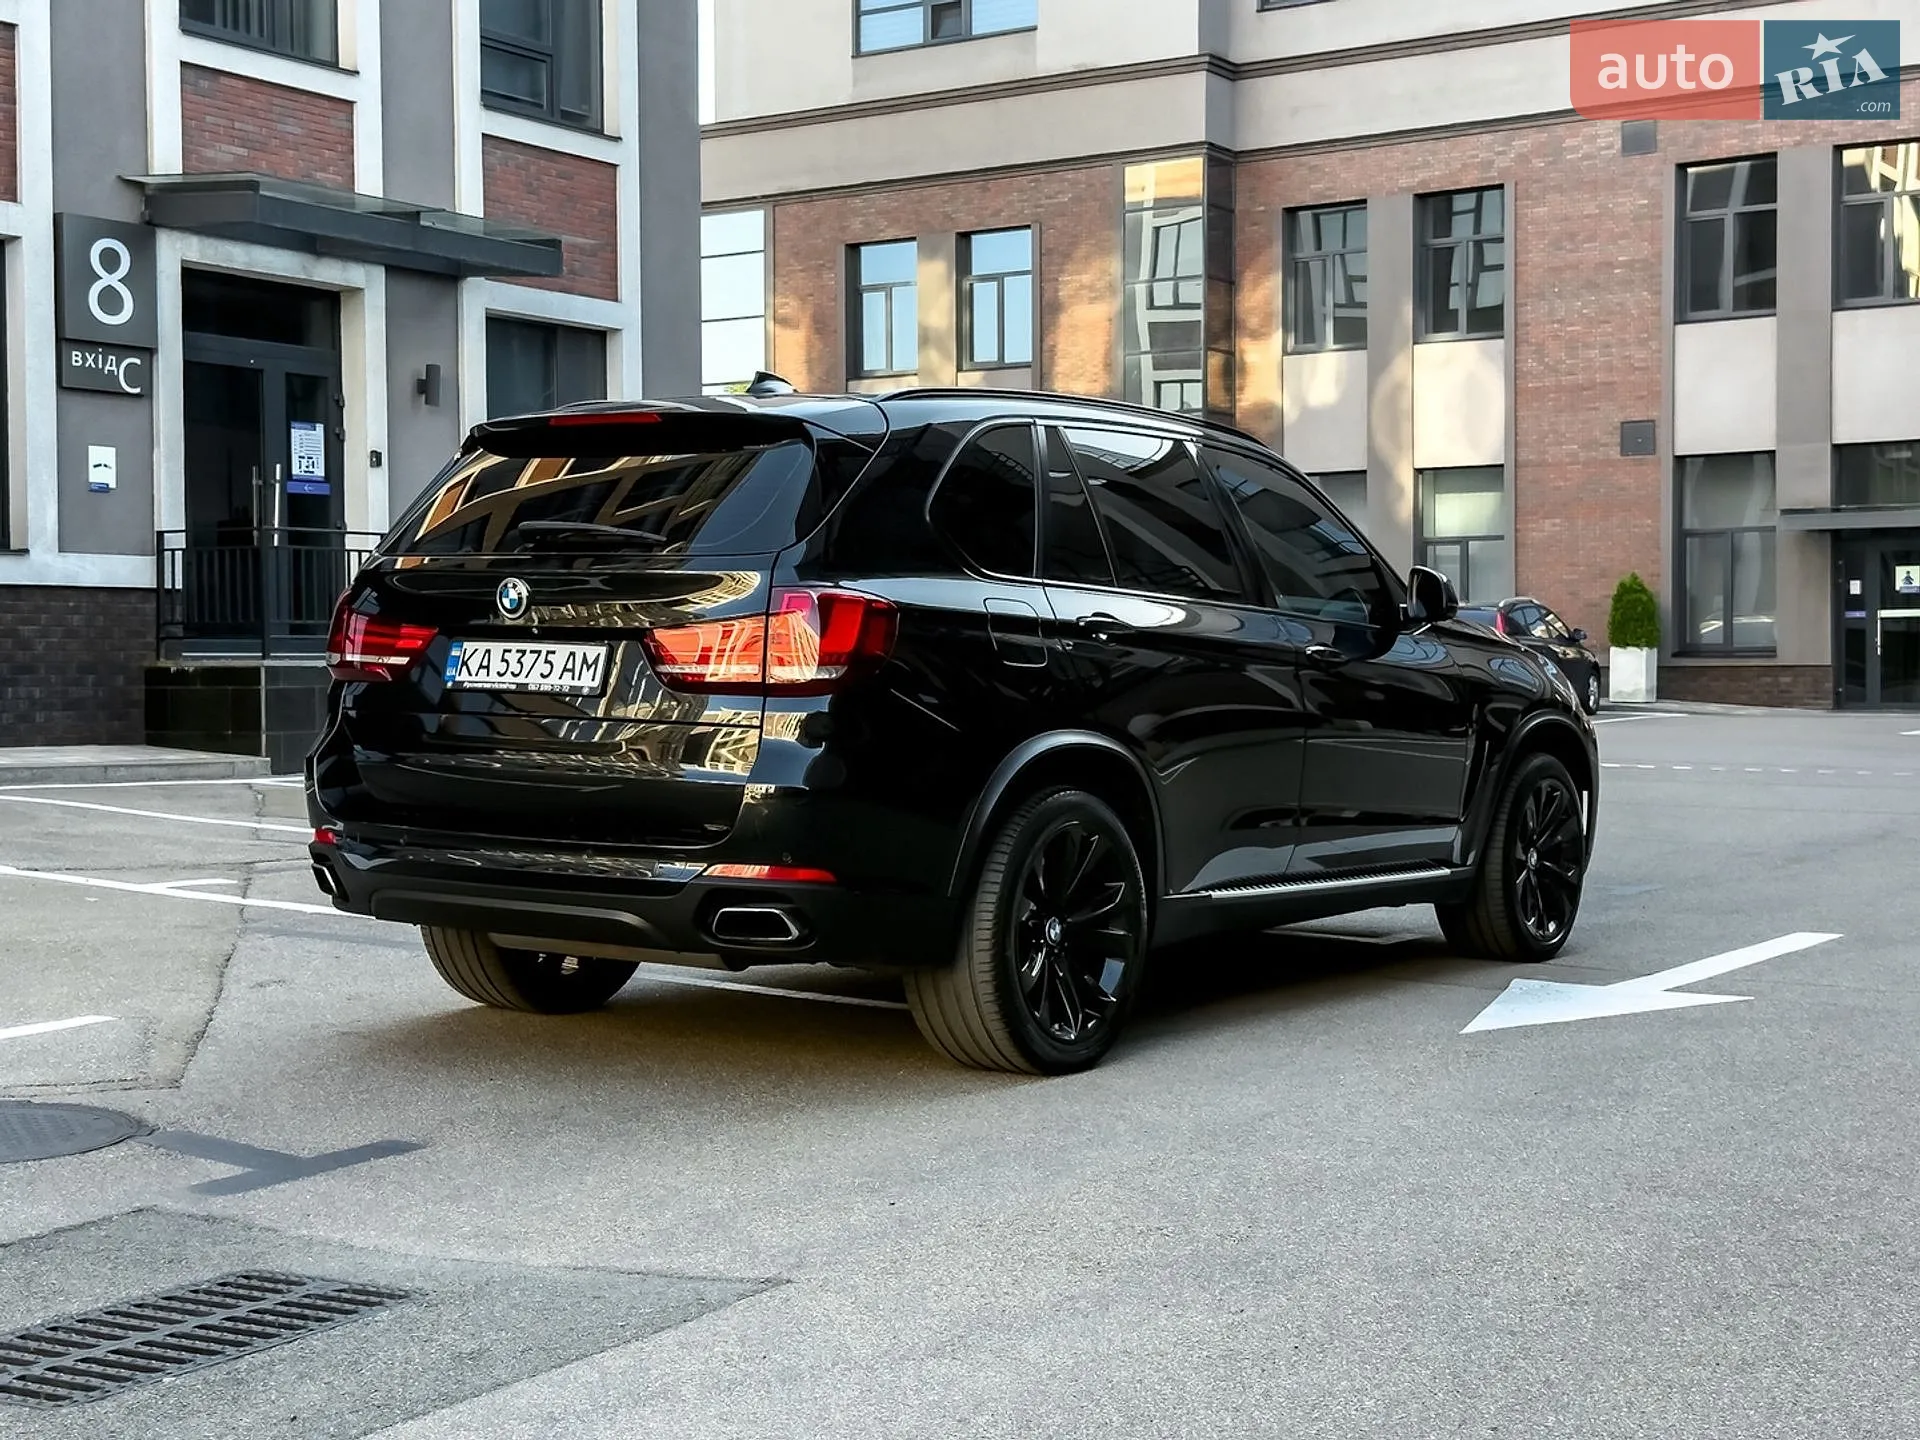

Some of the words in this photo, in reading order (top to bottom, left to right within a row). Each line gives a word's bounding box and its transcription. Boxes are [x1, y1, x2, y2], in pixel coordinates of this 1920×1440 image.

[88, 237, 135, 326] 8
[71, 348, 118, 376] вхід
[458, 648, 492, 677] KA
[496, 649, 556, 679] 5375
[558, 651, 601, 682] AM
